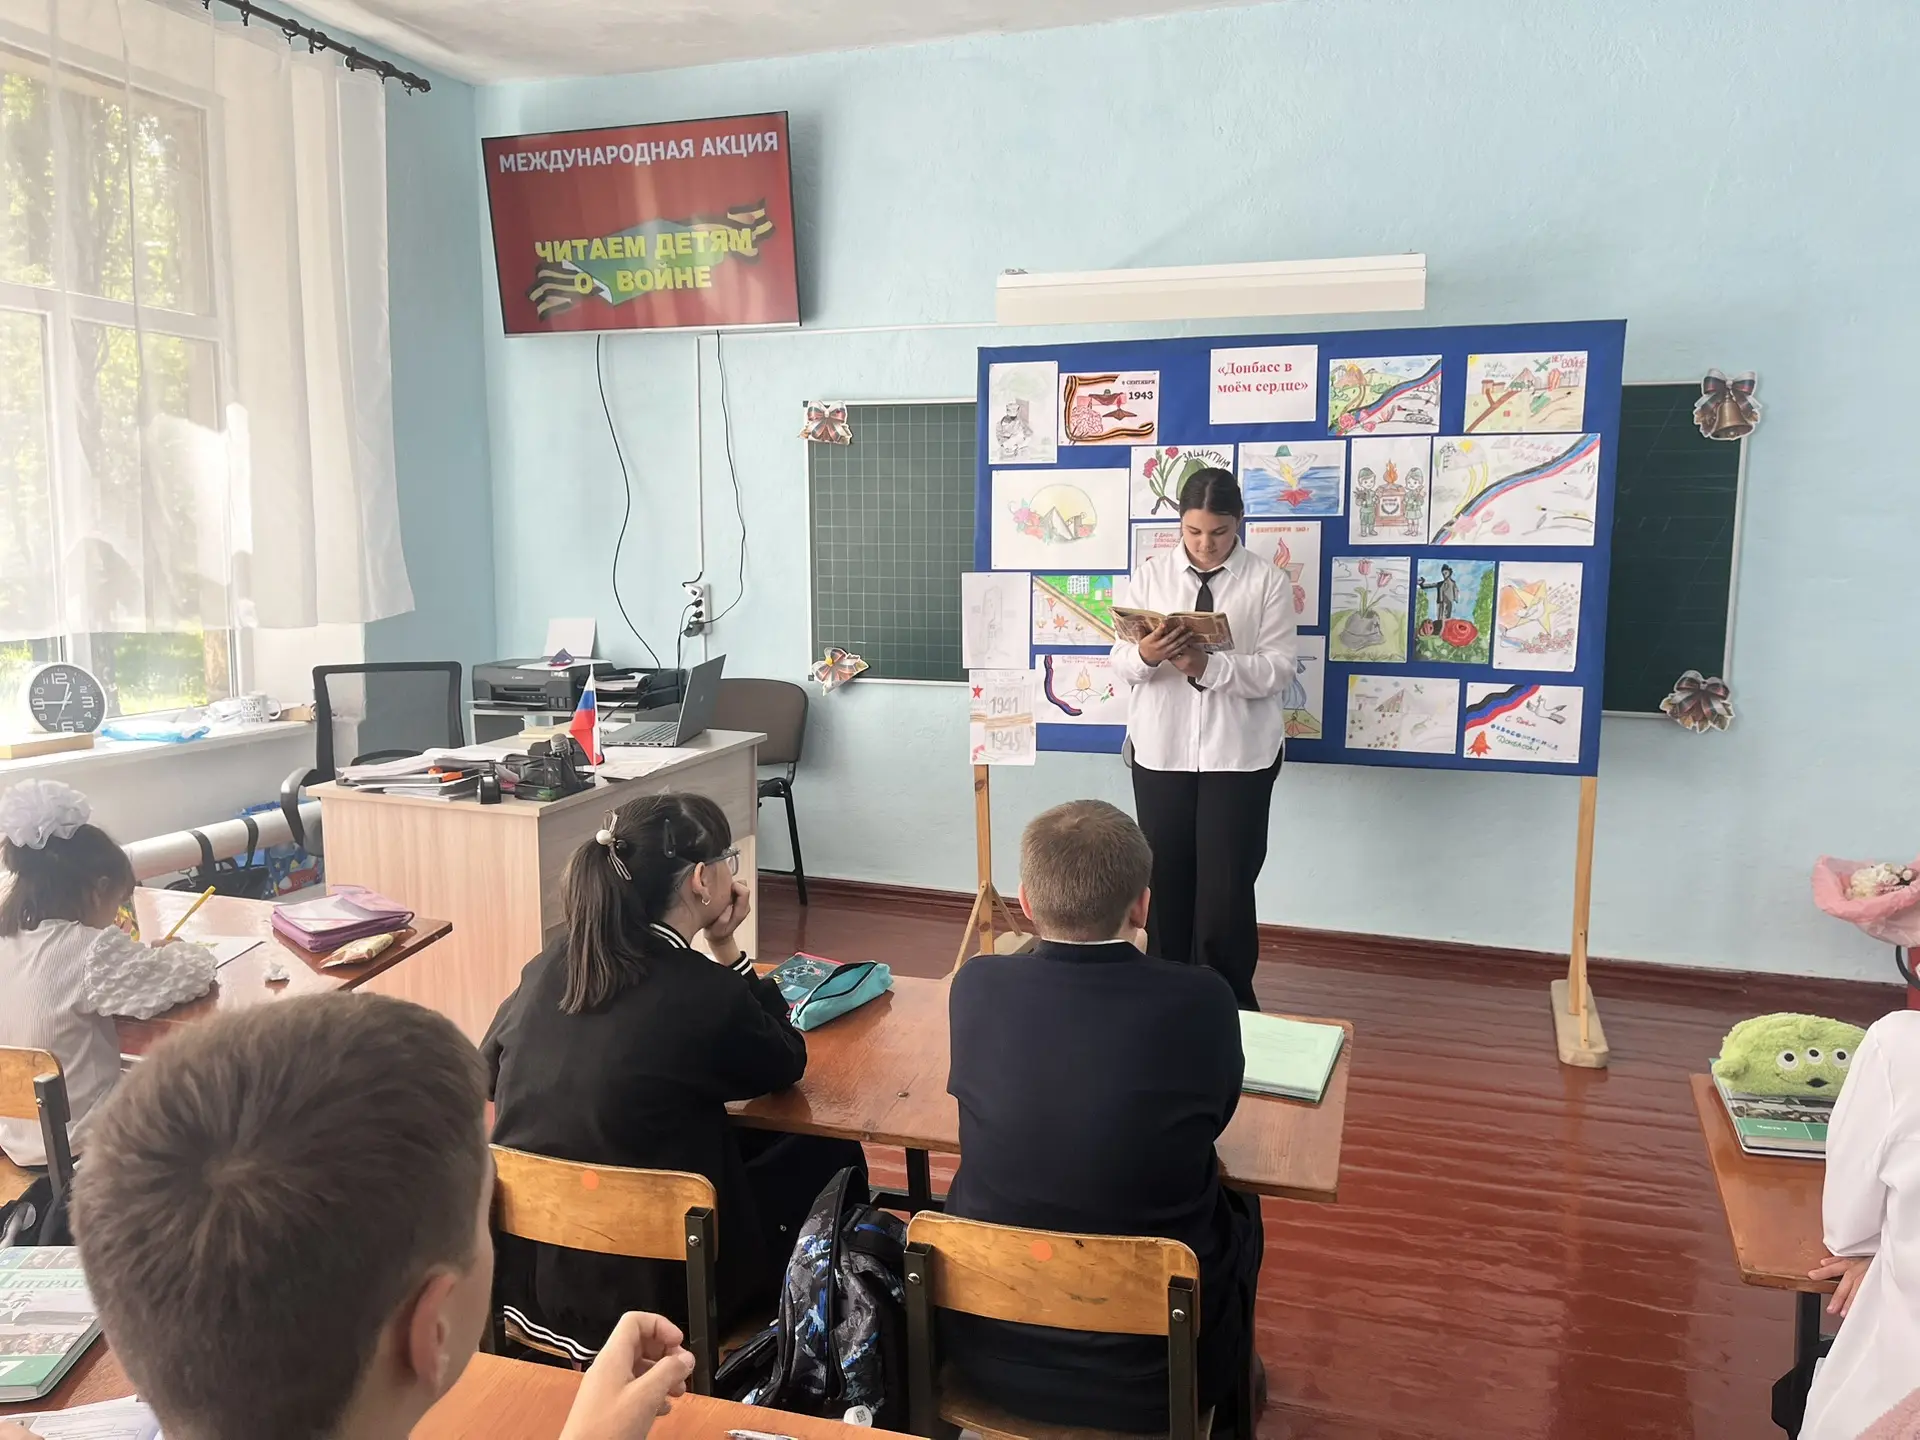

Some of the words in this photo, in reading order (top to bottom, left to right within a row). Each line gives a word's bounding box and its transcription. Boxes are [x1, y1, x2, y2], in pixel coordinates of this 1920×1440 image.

[499, 138, 694, 172] МЕЖДУНАРОДНАЯ
[702, 131, 779, 159] АКЦИЯ
[534, 235, 646, 263] ЧИТАЕМ
[654, 228, 753, 260] ДЕТЯМ
[573, 272, 593, 294] О
[616, 261, 712, 292] ВОЙНЕ
[1217, 362, 1281, 376] «Донбасс
[1284, 363, 1293, 372] в
[1217, 381, 1252, 393] моём
[1255, 381, 1309, 395] сердце»
[1128, 391, 1154, 400] 1943
[34, 687, 45, 695] 10
[79, 685, 88, 694] 2
[81, 696, 95, 708] 3
[989, 696, 1019, 714] 1941
[84, 711, 92, 719] 4
[75, 721, 85, 729] 5
